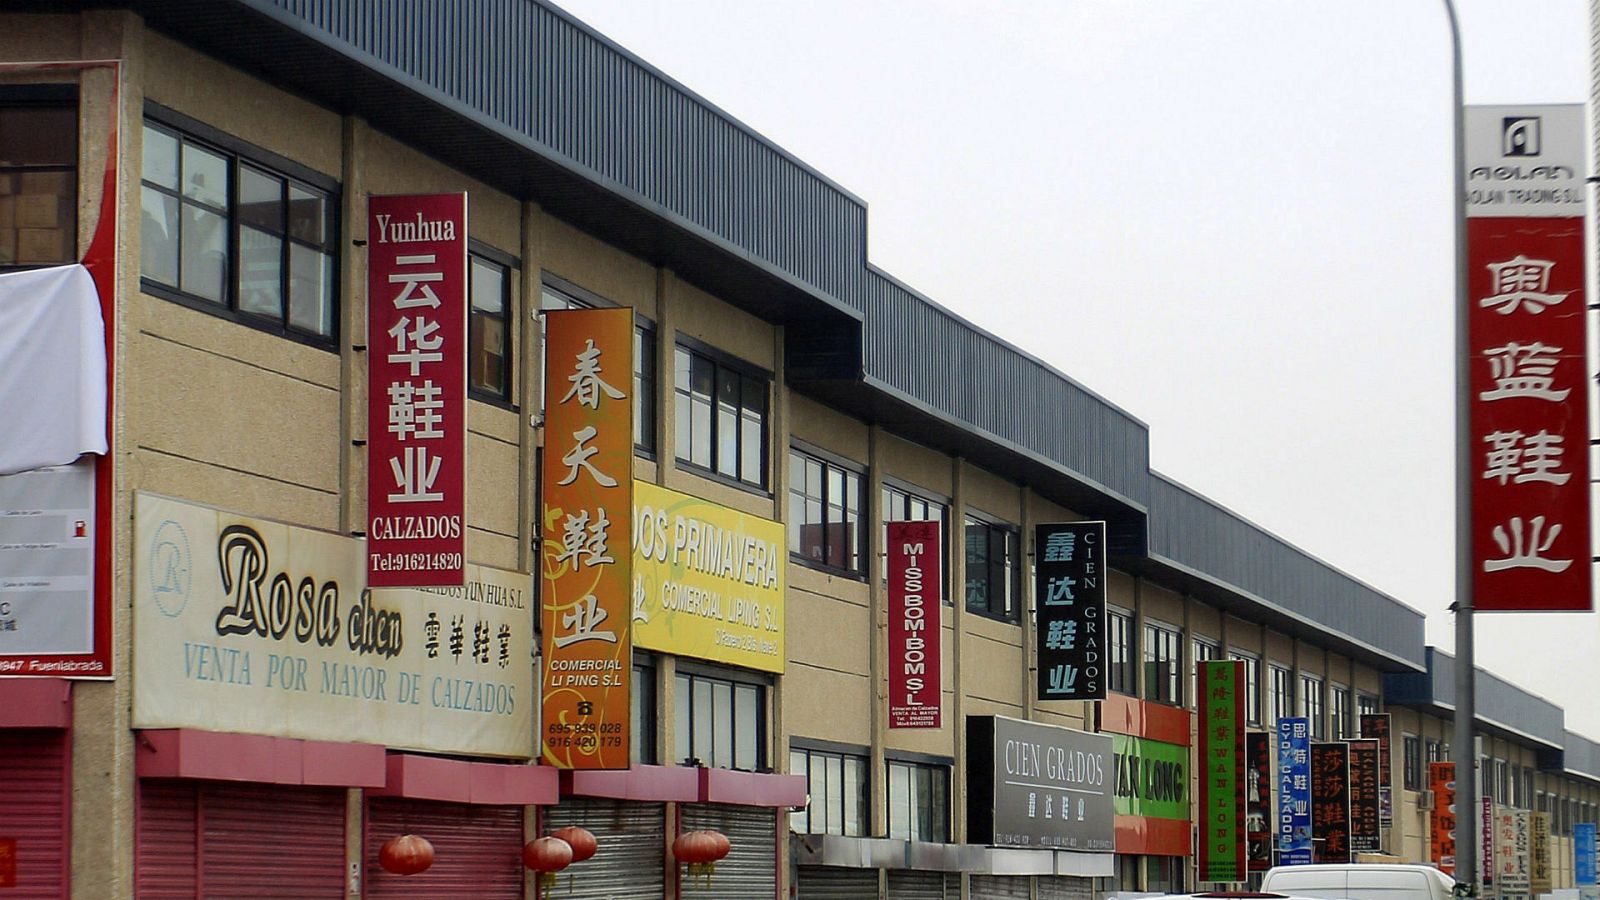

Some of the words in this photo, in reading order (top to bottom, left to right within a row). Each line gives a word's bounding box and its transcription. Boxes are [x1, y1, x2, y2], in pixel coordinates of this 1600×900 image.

[376, 212, 456, 244] Yunhua
[388, 254, 444, 503] 云华鞋业
[1479, 255, 1575, 574] 奥蓝鞋业
[553, 339, 627, 648] 春天鞋业
[371, 514, 461, 540] CALZADOS
[371, 550, 462, 572] Tel:916214820
[673, 514, 779, 591] PRIMAVERA
[903, 543, 923, 592] MISS
[1084, 532, 1097, 589] CIEN
[215, 524, 340, 647] Rosa
[348, 588, 403, 660] chen
[463, 581, 483, 603] YUN
[487, 584, 508, 609] HUA
[661, 580, 723, 621] COMERCIAL
[1043, 532, 1078, 694] 鑫达鞋业
[29, 660, 103, 671] Fuenlabrada
[551, 659, 622, 672] COMERCIAL
[1084, 607, 1098, 693] GRADOS
[184, 642, 252, 686] VENTA
[266, 653, 308, 692] POR
[319, 661, 387, 701] MAYOR
[397, 671, 421, 705] DE
[432, 676, 516, 715] CALZADOS
[551, 674, 563, 687] LI
[566, 674, 599, 687] PING
[549, 723, 571, 734] 695
[600, 723, 622, 734] 028
[1005, 739, 1040, 778] CIEN
[1046, 746, 1103, 786] GRADOS
[1144, 758, 1184, 804] LONG
[1214, 748, 1229, 789] WAN
[1216, 798, 1229, 854] LONG
[1281, 765, 1293, 843] CALZADOS
